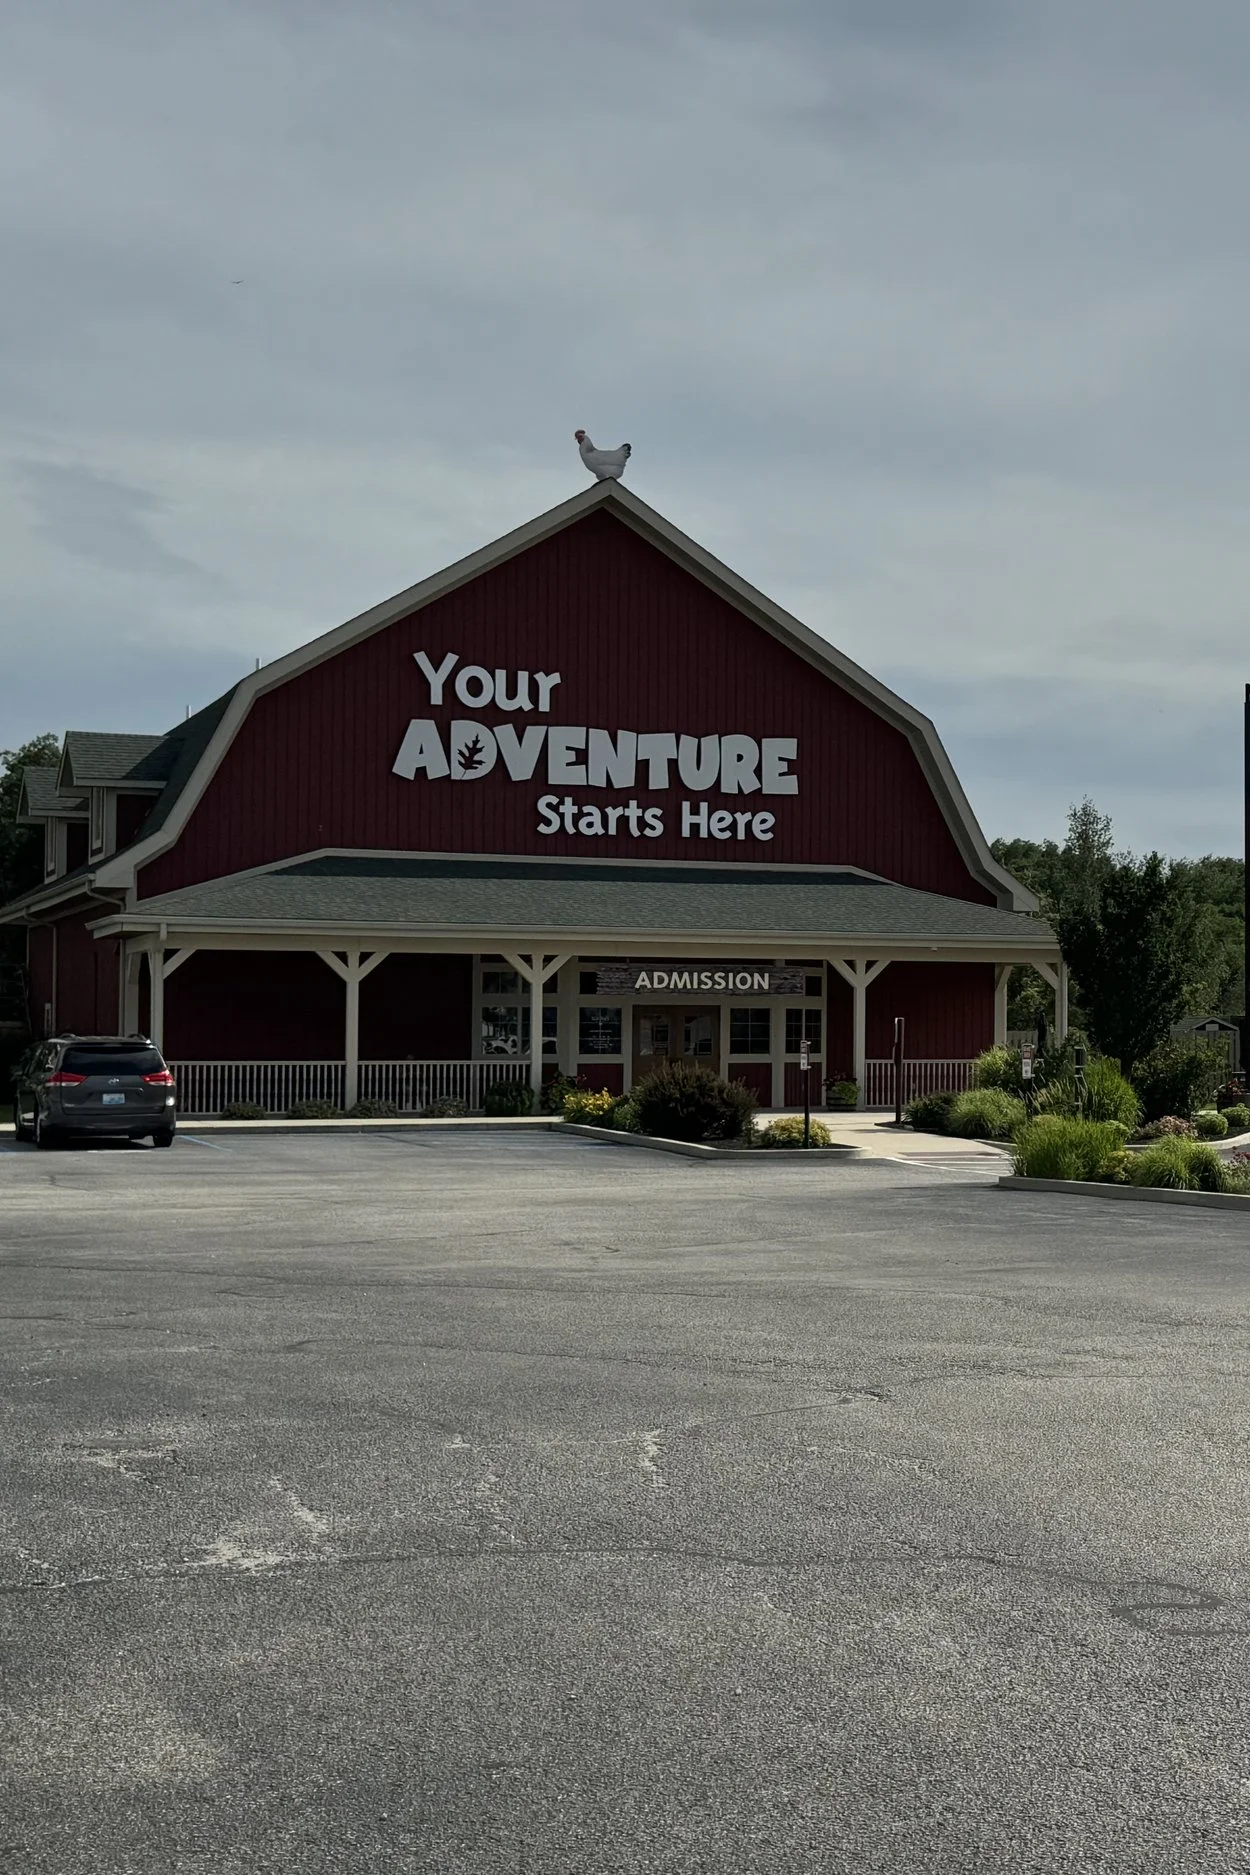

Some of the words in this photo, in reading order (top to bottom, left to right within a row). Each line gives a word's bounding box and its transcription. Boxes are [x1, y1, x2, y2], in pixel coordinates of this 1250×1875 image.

[413, 650, 562, 713] Your
[392, 718, 799, 795] ADVENTURE
[536, 794, 664, 838] Starts
[681, 801, 776, 841] Here
[634, 971, 770, 990] ADMISSION
